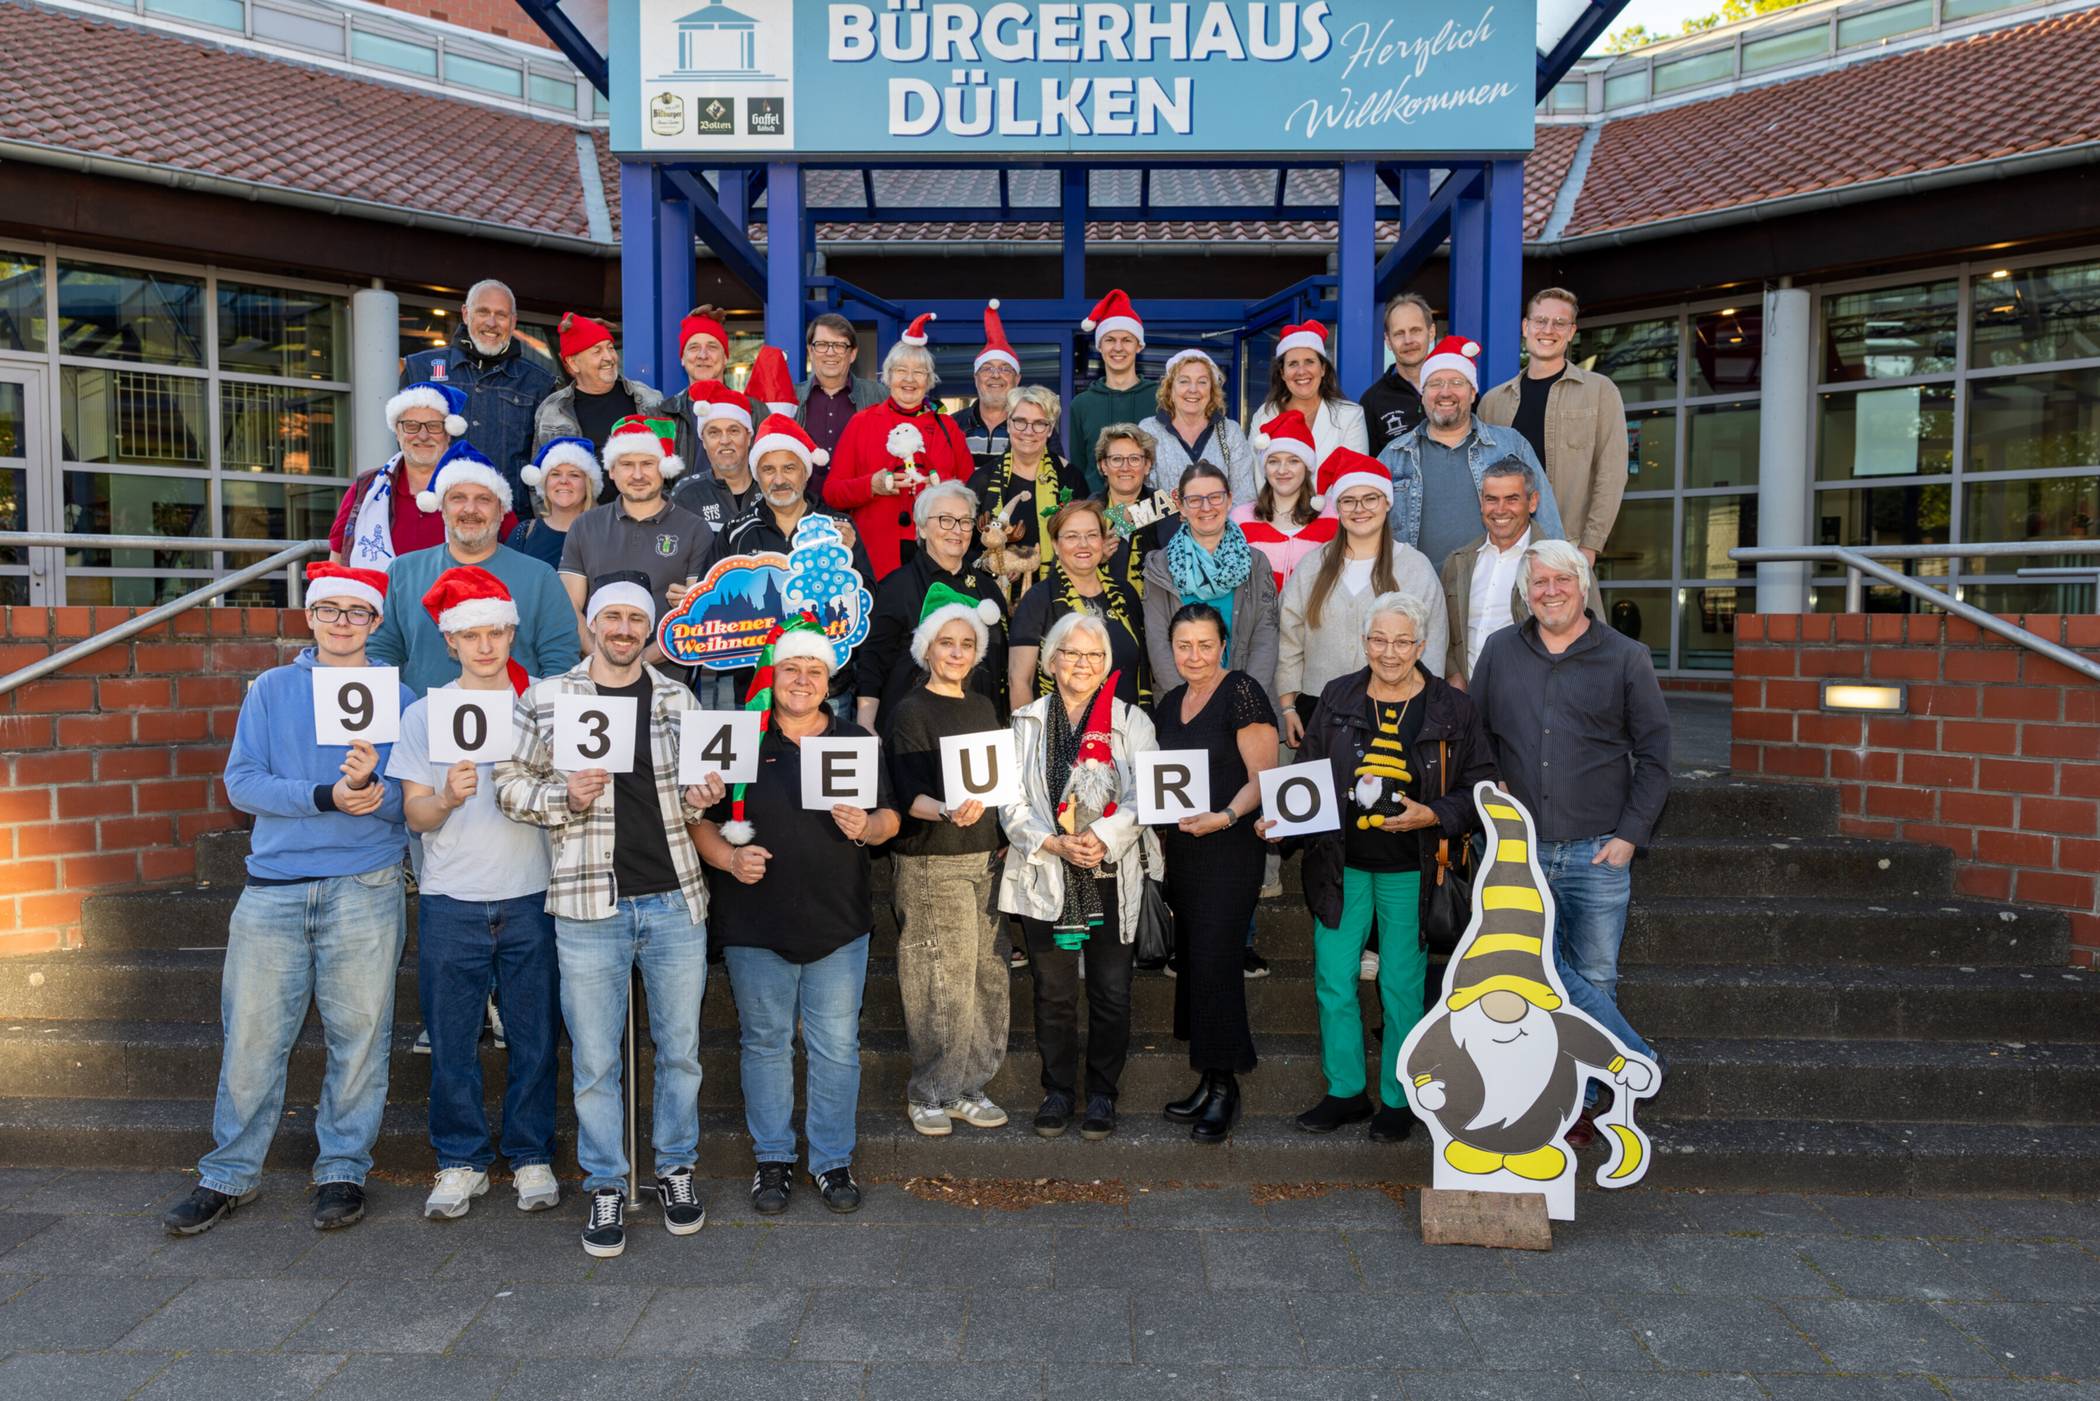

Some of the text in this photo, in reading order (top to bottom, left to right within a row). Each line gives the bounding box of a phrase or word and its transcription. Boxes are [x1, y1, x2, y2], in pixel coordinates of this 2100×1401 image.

[828, 0, 1333, 63] BÜRGERHAUS
[1340, 6, 1496, 79] Herzlich
[752, 113, 780, 125] Gaffel
[888, 69, 1194, 137] DÜLKEN
[1284, 75, 1518, 139] Willkommen
[702, 503, 720, 512] JAKO
[704, 509, 721, 520] STS
[674, 634, 769, 655] Weihnac
[338, 682, 1321, 823] 9 0 3 4 E U R O
